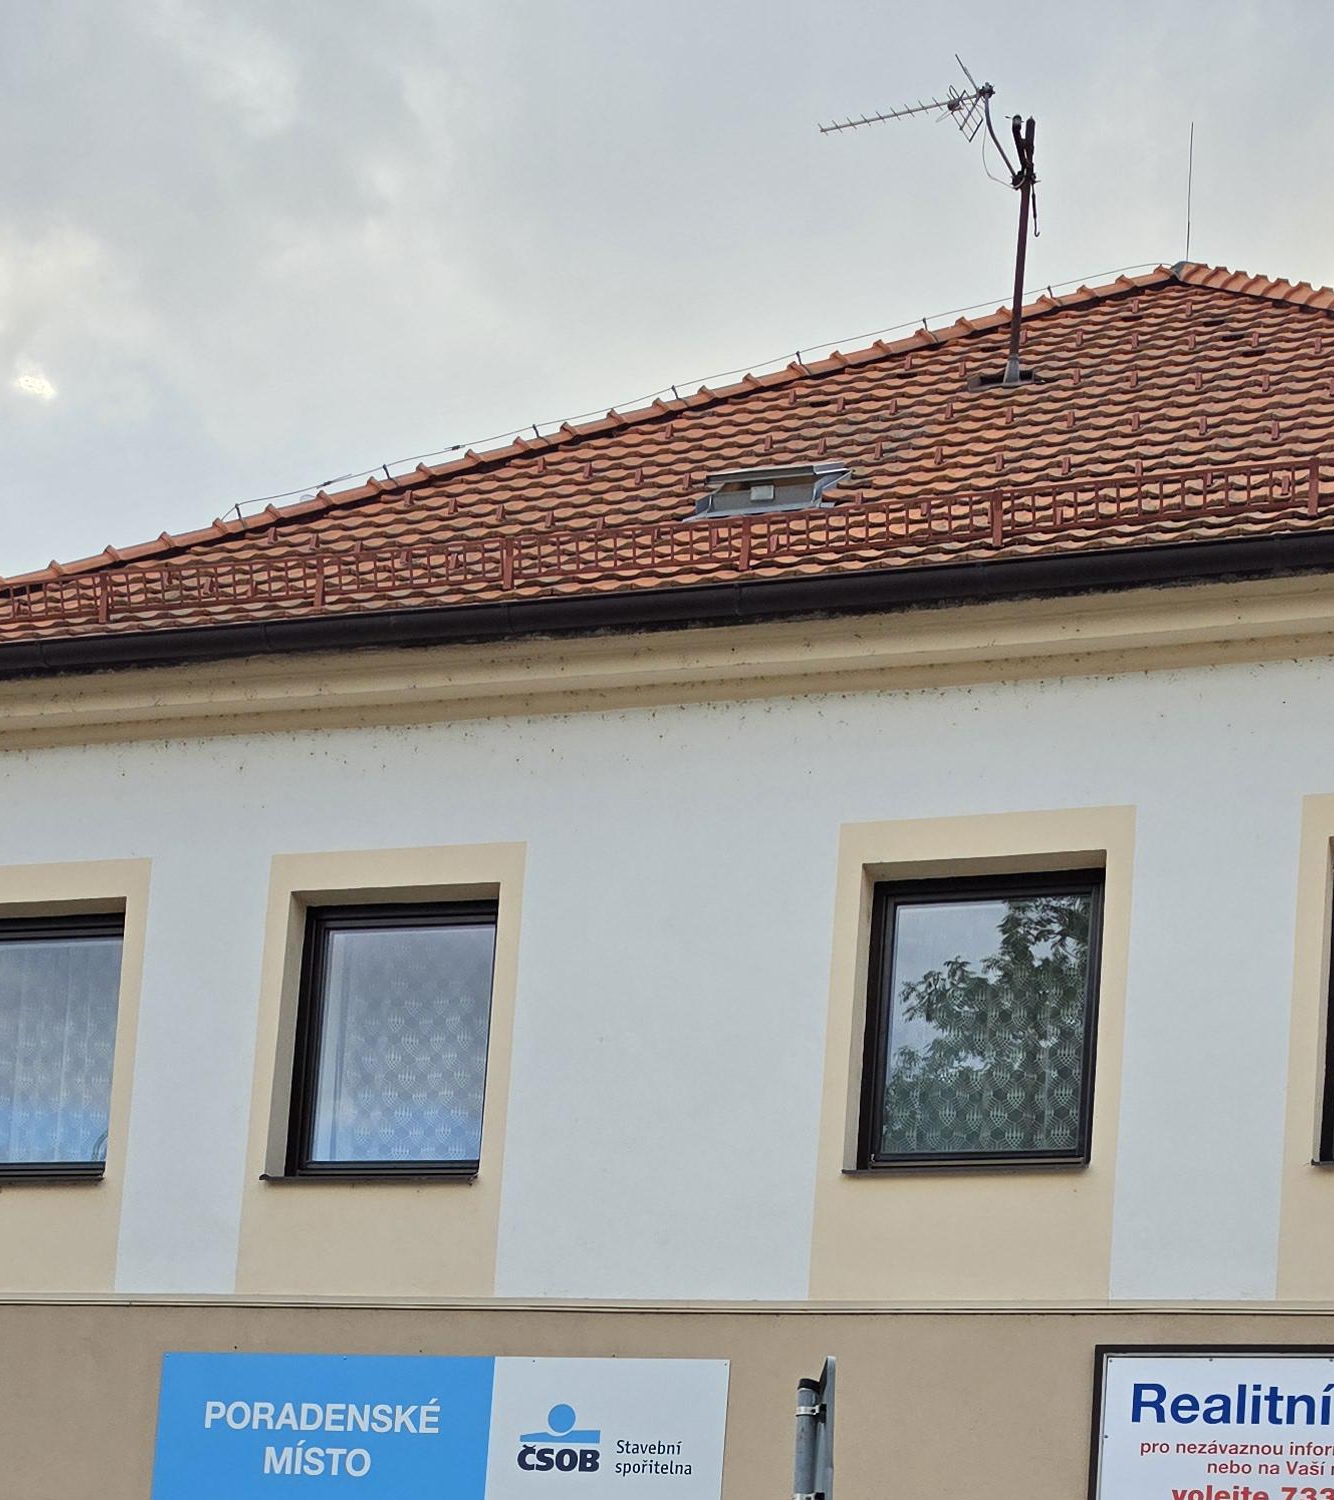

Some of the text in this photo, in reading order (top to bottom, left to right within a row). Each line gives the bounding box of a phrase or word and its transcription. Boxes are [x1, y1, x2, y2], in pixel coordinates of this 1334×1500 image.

[204, 1399, 441, 1434] PORADENSKÉ
[616, 1439, 682, 1455] Stavební
[1140, 1442, 1169, 1456] pro
[1176, 1442, 1283, 1457] nezávaznou
[263, 1440, 370, 1476] MÍSTO
[517, 1444, 599, 1473] ČSOB
[615, 1458, 692, 1476] spořitelna
[1207, 1461, 1252, 1475] nebo
[1258, 1465, 1280, 1475] na
[1286, 1461, 1325, 1476] Vaší
